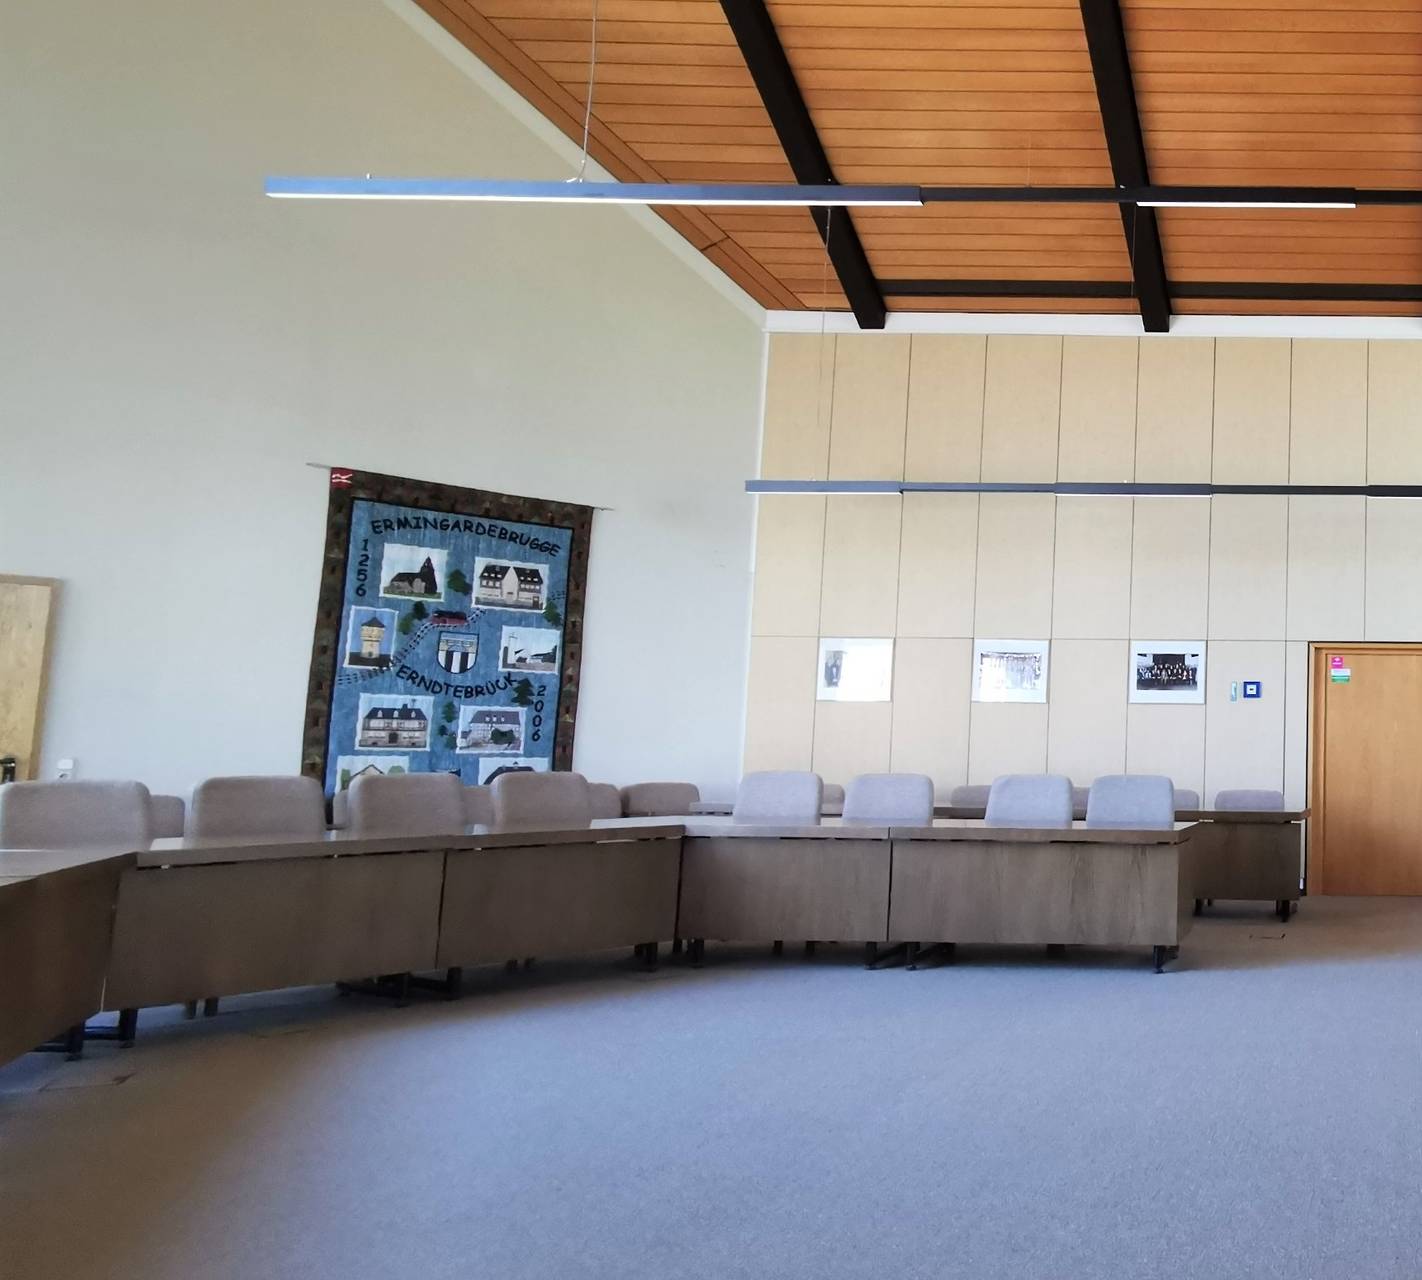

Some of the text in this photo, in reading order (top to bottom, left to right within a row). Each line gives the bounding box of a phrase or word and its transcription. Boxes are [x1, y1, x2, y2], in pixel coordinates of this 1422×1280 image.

[371, 516, 562, 558] ERMINGARDEBRUGGE
[355, 538, 370, 598] 1256
[395, 664, 518, 699] ERNDTEBRÜCK
[531, 685, 547, 743] 2006
